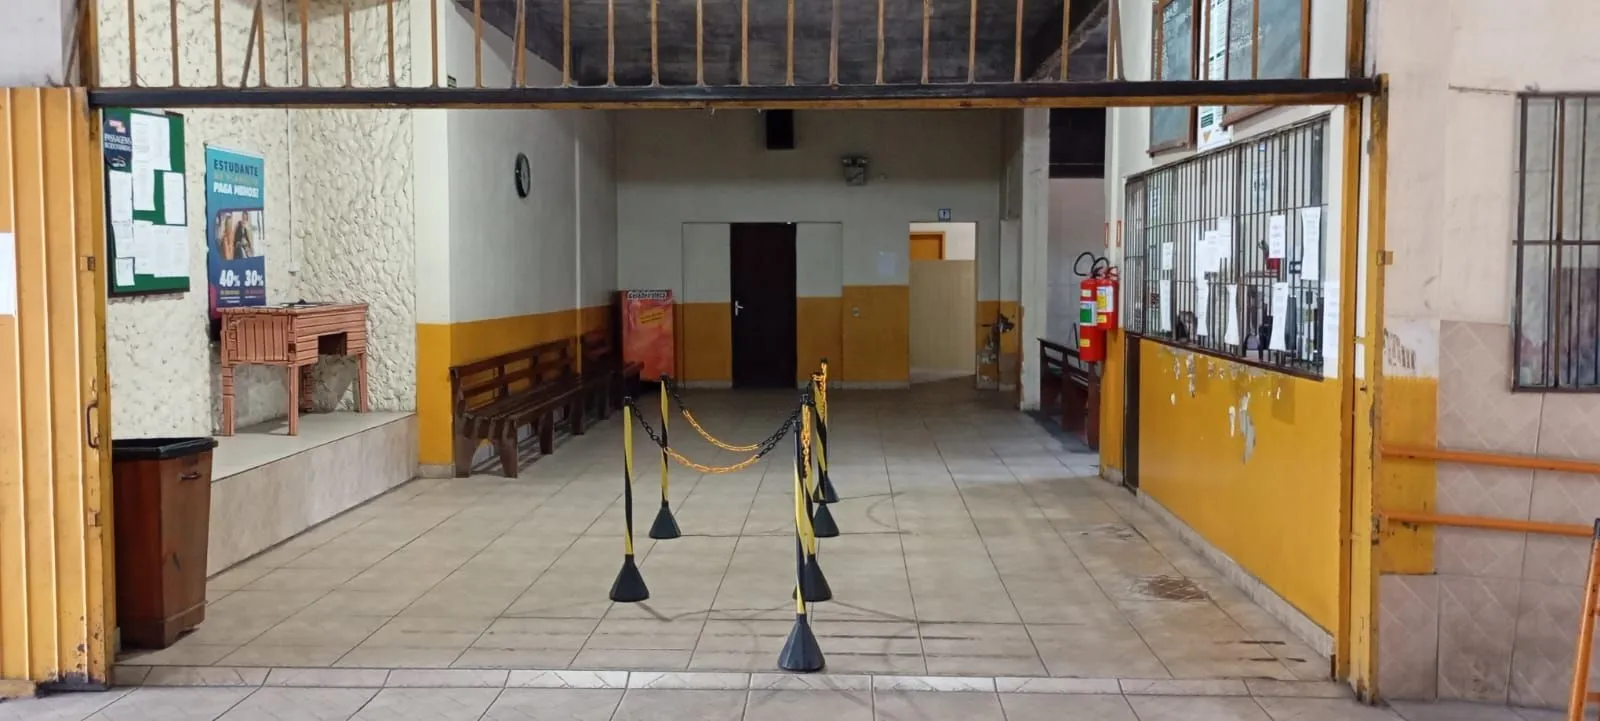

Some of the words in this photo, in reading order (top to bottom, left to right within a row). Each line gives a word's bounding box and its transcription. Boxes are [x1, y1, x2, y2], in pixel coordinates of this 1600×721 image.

[213, 158, 258, 177] ESTUDANTE
[213, 181, 233, 195] PAGA
[219, 269, 241, 287] 40%
[244, 269, 264, 287] 30%
